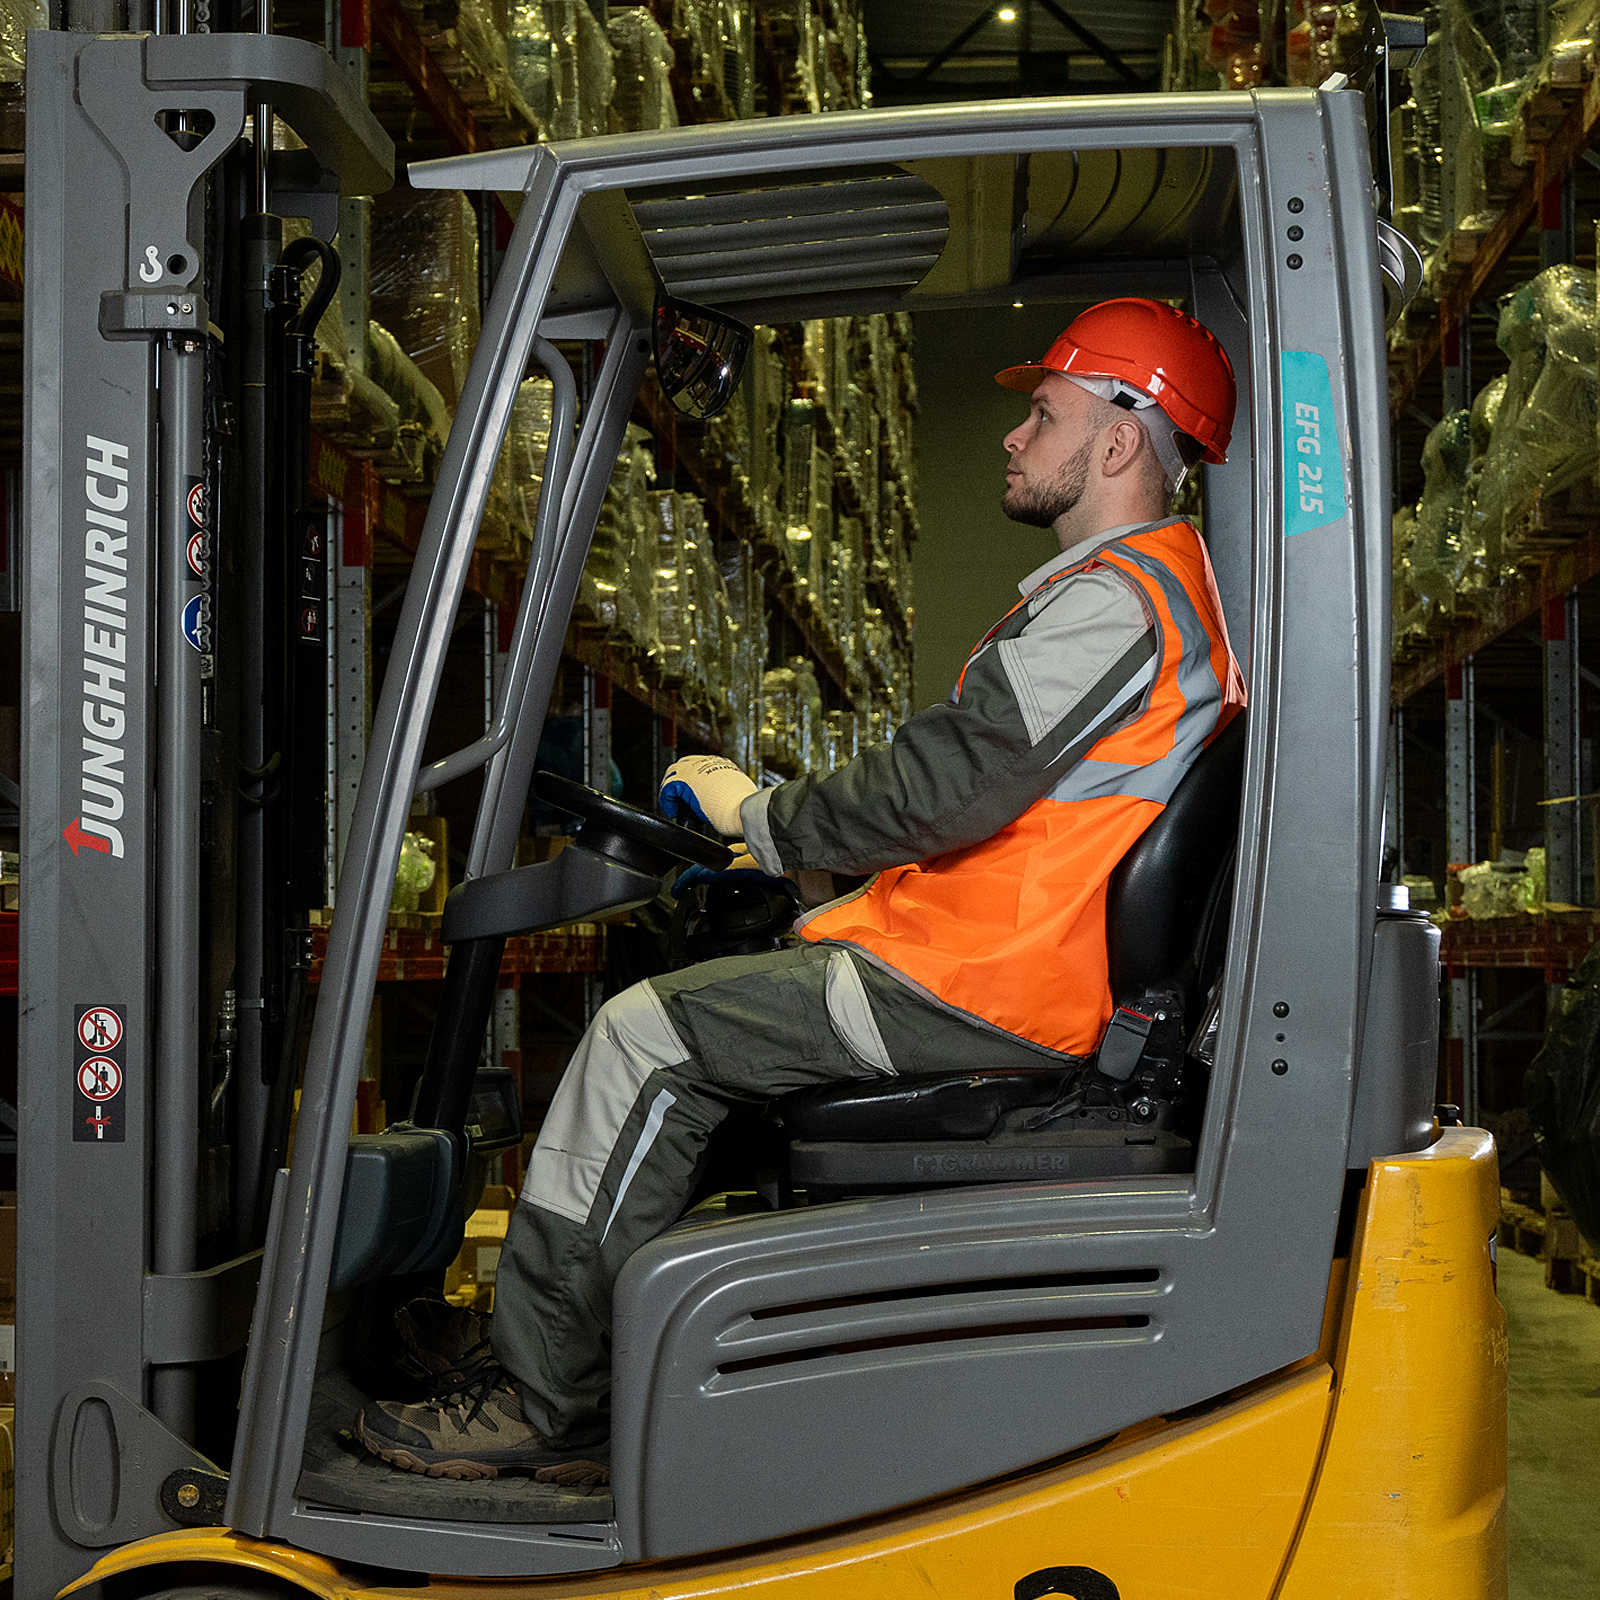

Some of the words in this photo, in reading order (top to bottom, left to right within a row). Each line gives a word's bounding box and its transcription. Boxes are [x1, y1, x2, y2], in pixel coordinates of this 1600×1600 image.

[1295, 402, 1321, 455] EFG
[1298, 462, 1324, 514] 215
[81, 434, 129, 859] JUNGHEINRICH
[942, 1153, 1065, 1173] GRAMMER
